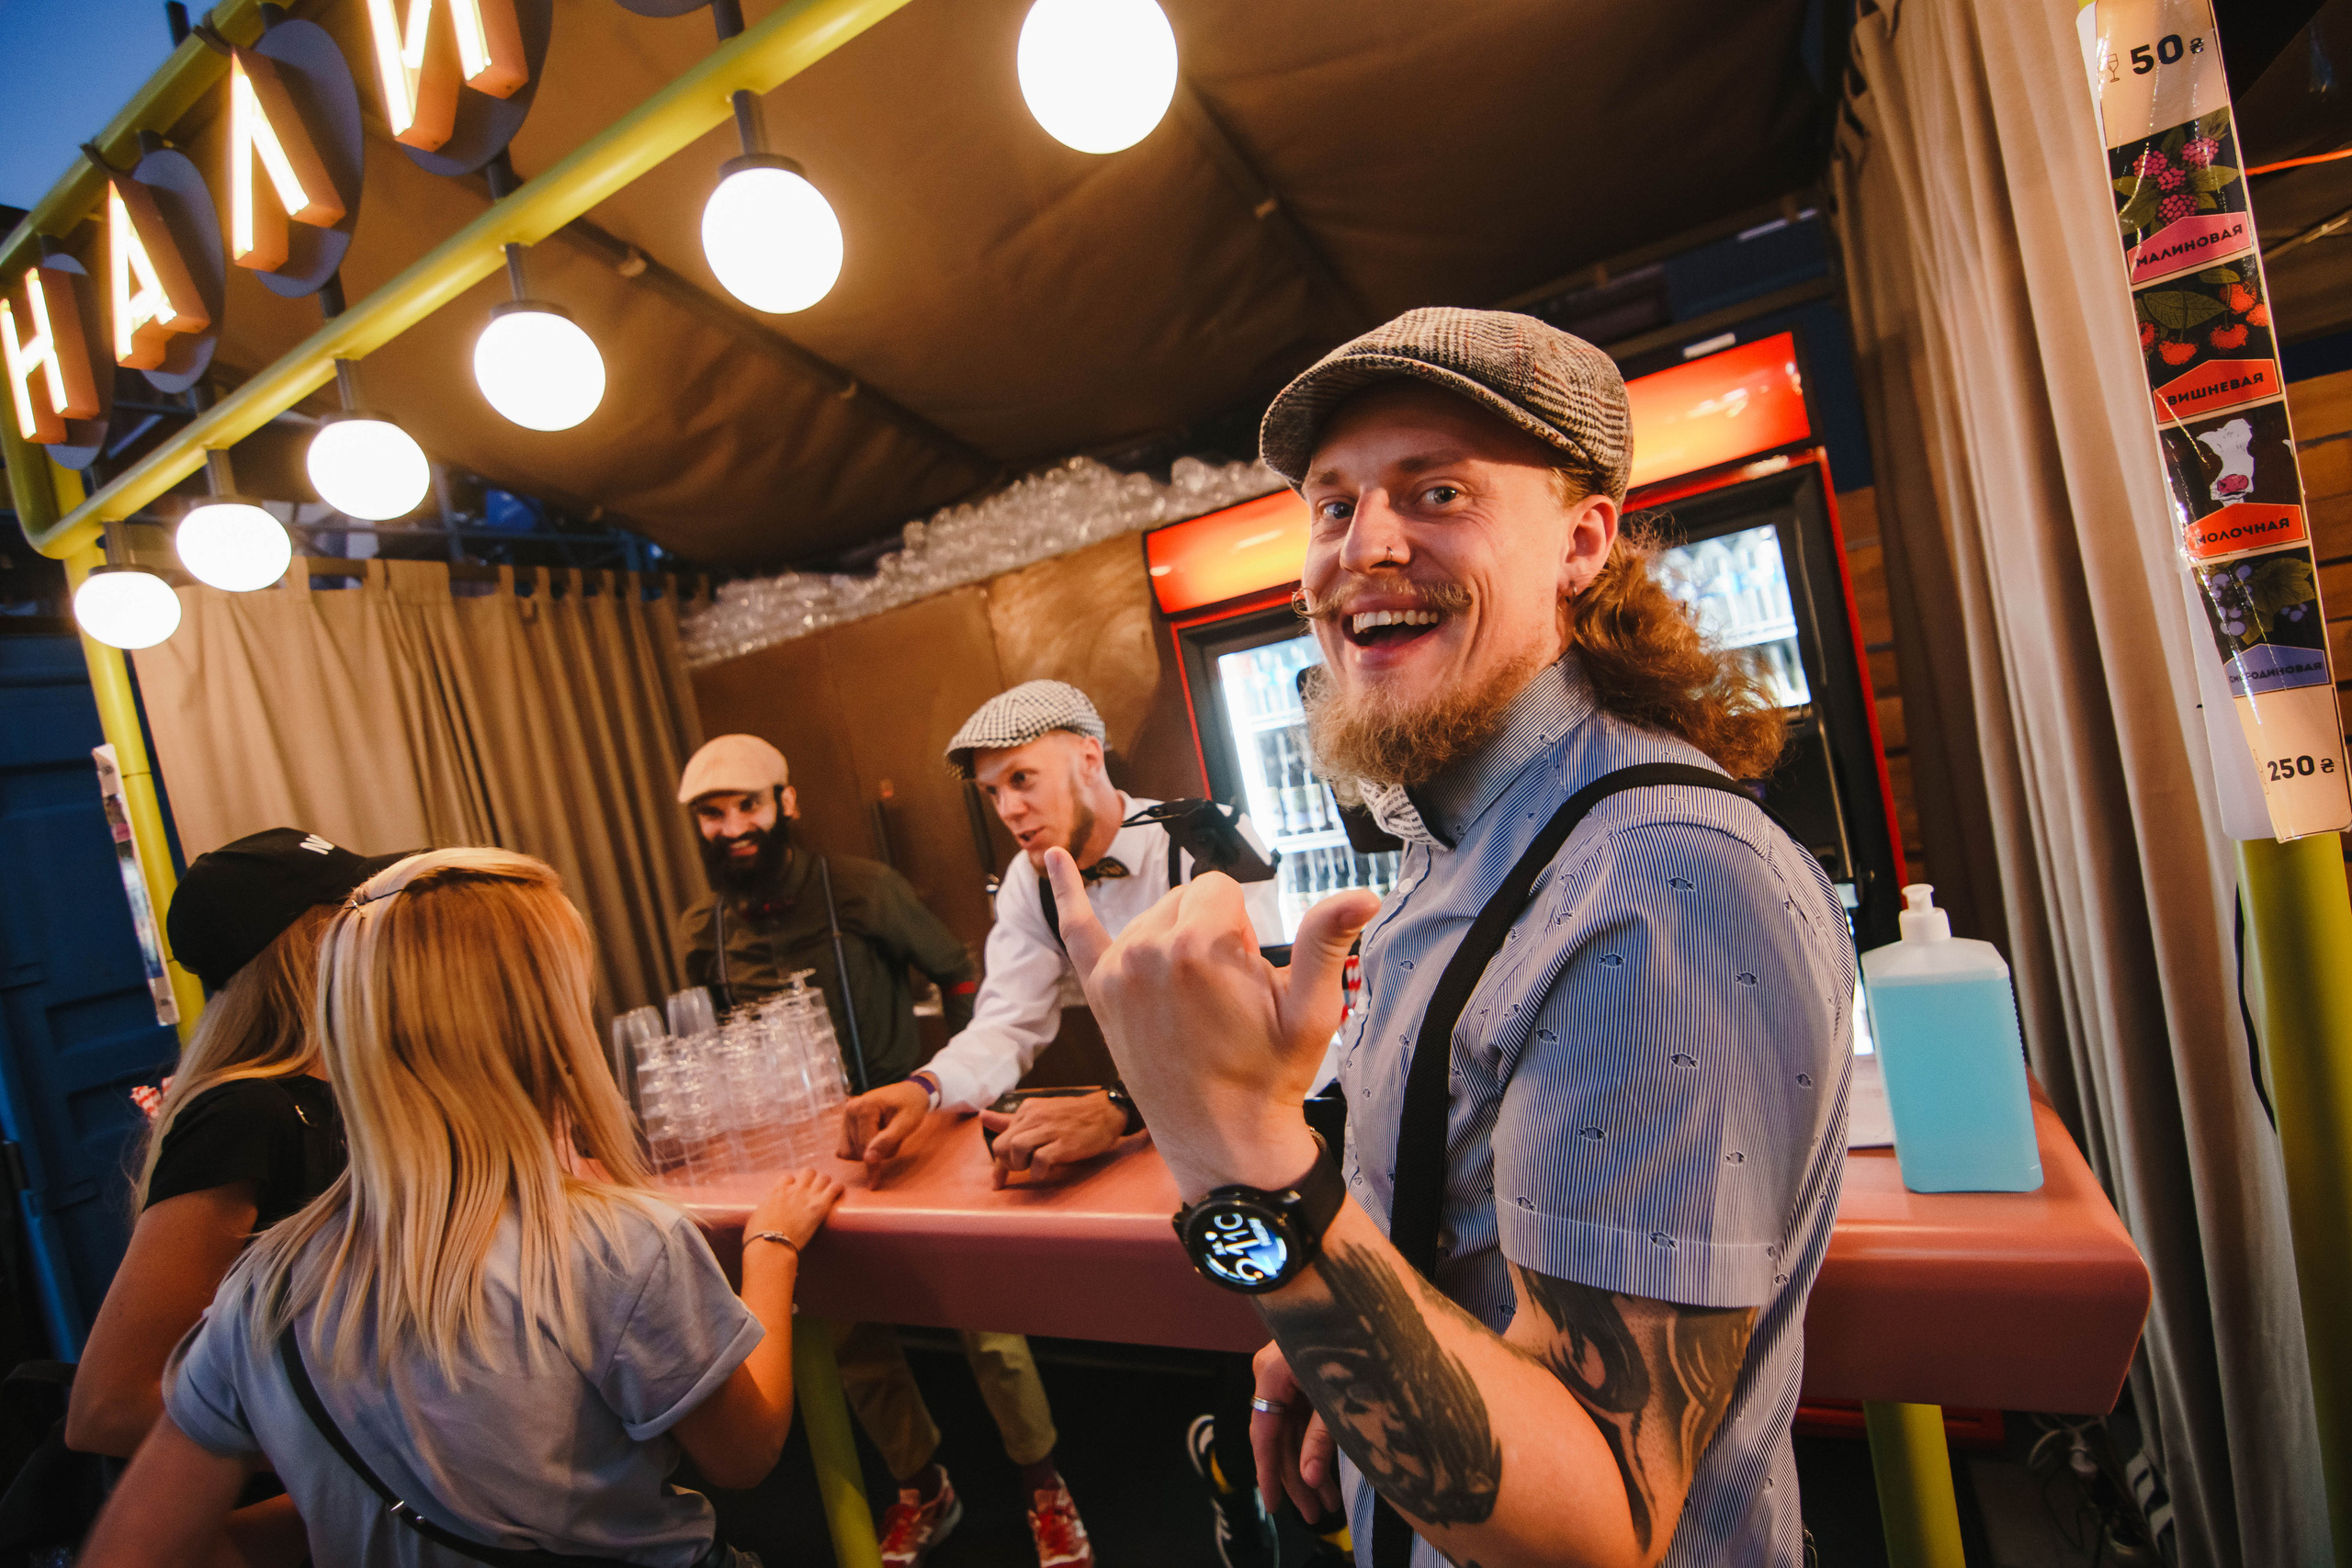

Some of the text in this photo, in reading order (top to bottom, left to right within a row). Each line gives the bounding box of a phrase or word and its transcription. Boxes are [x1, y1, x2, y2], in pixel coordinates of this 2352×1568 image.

[2130, 34, 2184, 75] 50
[2136, 223, 2243, 267] МАЛИНОВАЯ
[2166, 372, 2264, 406] ВИШНЕВАЯ
[2267, 755, 2315, 782] 250
